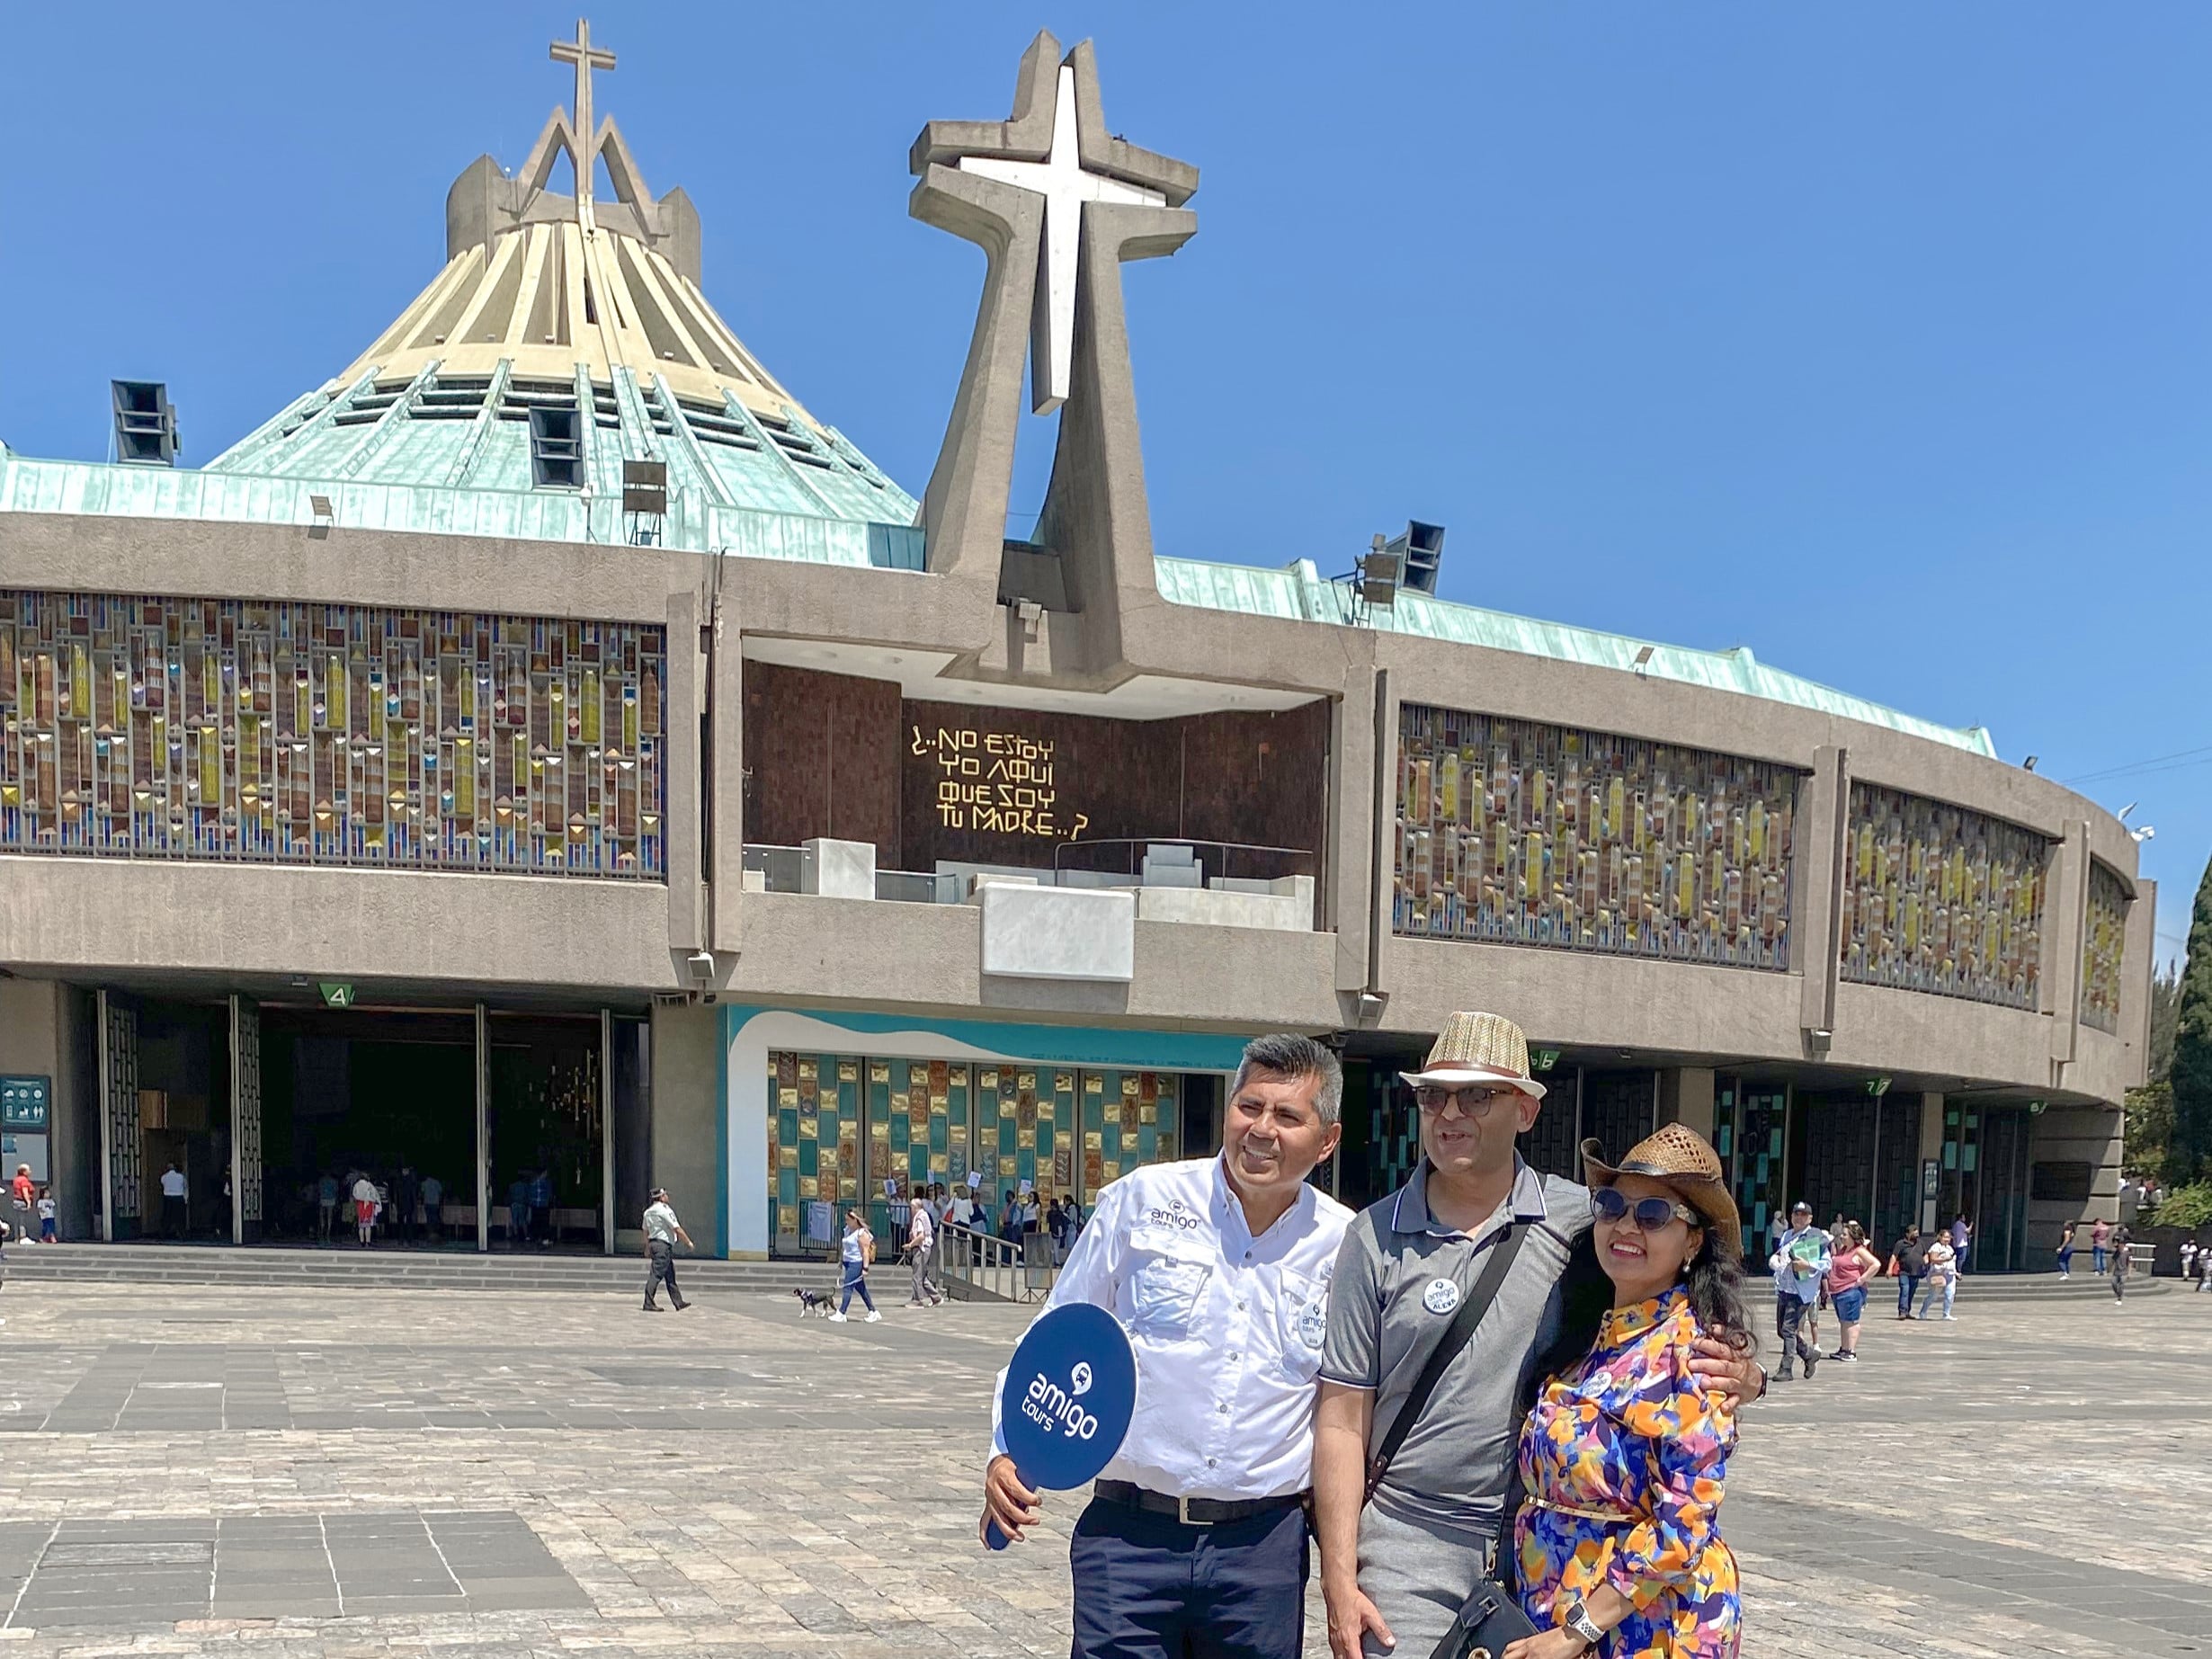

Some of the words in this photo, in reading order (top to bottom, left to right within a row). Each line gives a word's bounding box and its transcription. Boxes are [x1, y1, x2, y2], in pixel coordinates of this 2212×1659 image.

[939, 753, 980, 777] YO
[939, 780, 993, 805] QUE
[997, 784, 1055, 809] SOY
[936, 802, 963, 828] TU
[330, 987, 347, 1006] 4
[1867, 1081, 1876, 1093] 7
[1151, 1208, 1197, 1230] amigo
[1151, 1217, 1173, 1229] tours
[1428, 1288, 1455, 1302] amigo
[1303, 1316, 1326, 1331] amigo
[1021, 1396, 1055, 1432] tours
[1029, 1372, 1098, 1440] amigo
